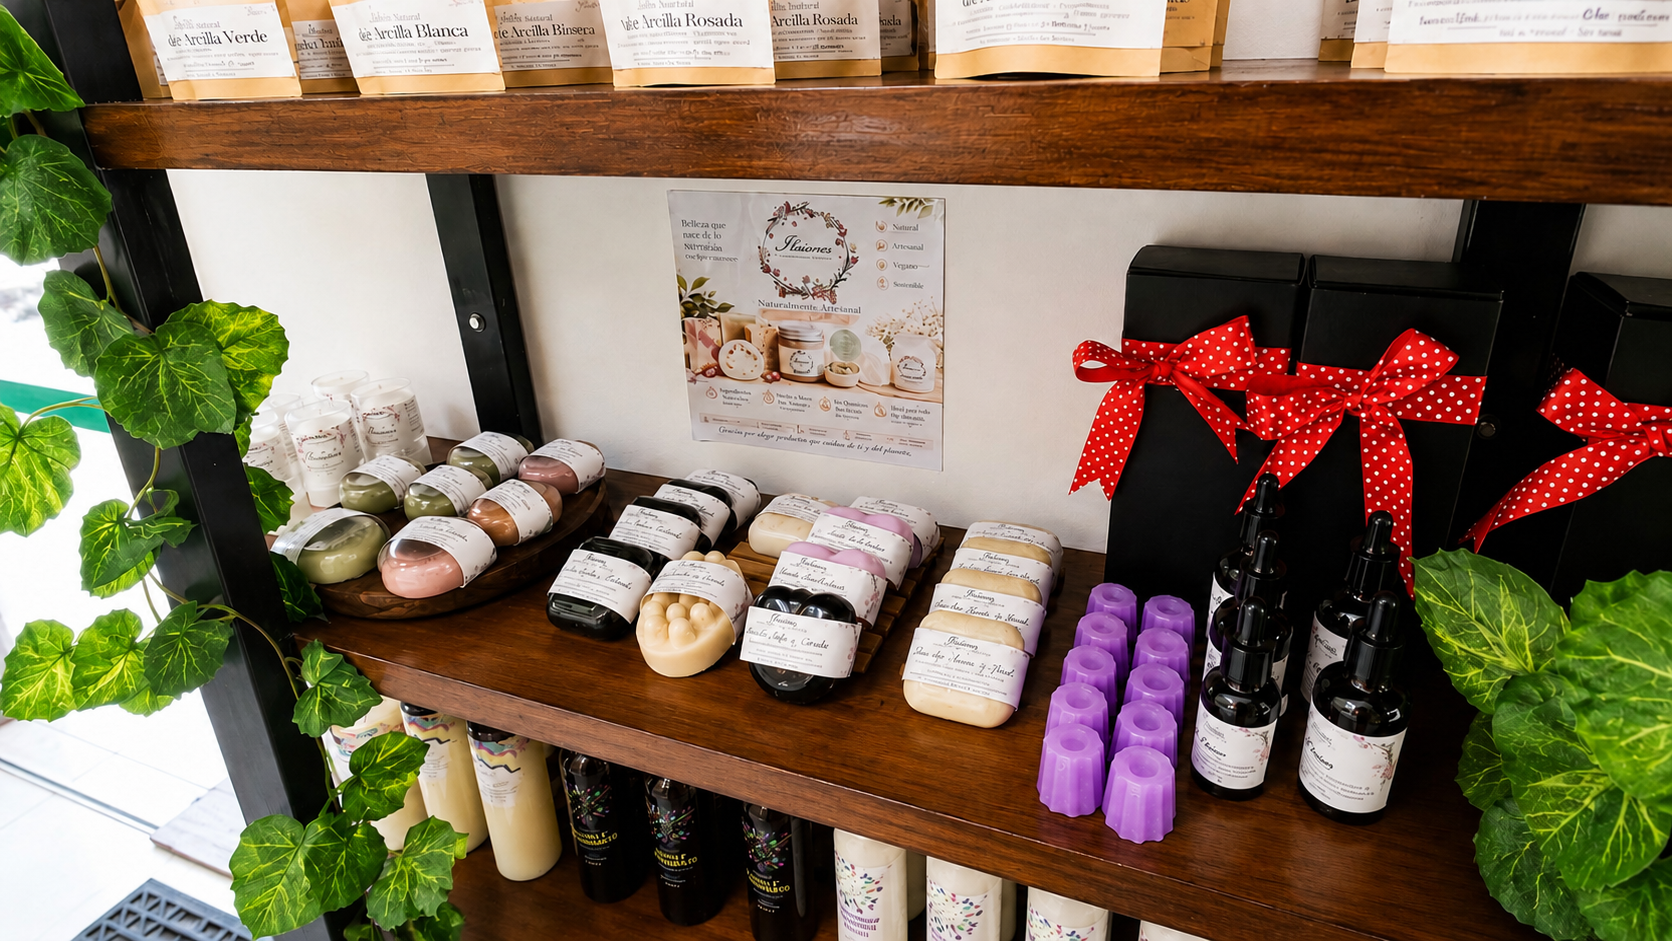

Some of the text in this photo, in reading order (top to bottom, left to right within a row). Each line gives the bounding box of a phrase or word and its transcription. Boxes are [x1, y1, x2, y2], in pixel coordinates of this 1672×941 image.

[642, 12, 682, 28] Arcilla
[685, 12, 743, 28] Rosada
[772, 12, 859, 28] Arcilla Rosada
[184, 31, 222, 46] Arcilla
[222, 29, 268, 43] Verde
[374, 24, 413, 39] Arcilla
[414, 23, 469, 38] Blanca
[511, 24, 550, 38] Arcilla
[551, 23, 596, 36] Binsera
[681, 219, 727, 231] Belleza que
[892, 223, 919, 231] Natural
[758, 299, 862, 314] Naturalmente Artesanal
[870, 444, 884, 453] del
